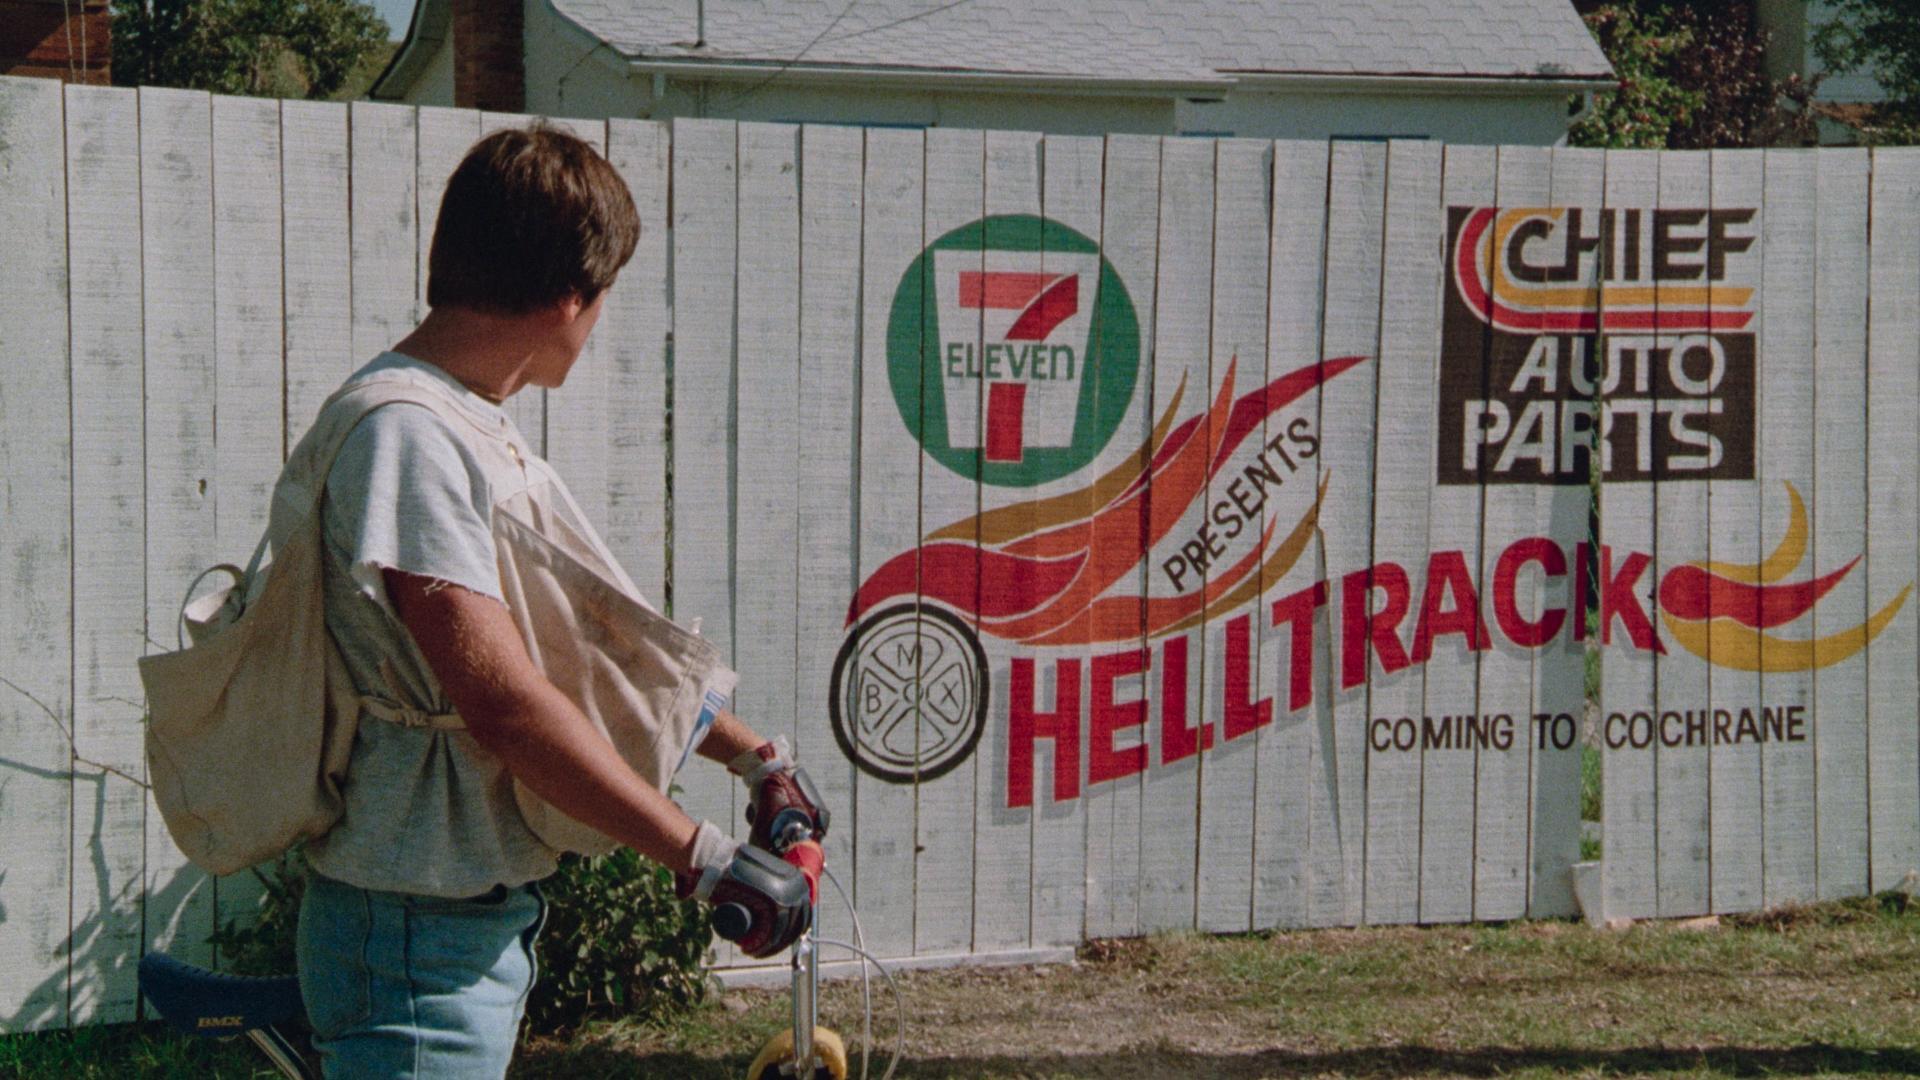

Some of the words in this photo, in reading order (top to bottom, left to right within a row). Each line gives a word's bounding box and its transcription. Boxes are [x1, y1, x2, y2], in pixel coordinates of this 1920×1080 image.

[1507, 208, 1757, 282] CHIEF
[959, 272, 1078, 462] 7
[1509, 335, 1725, 395] AUTO
[1462, 398, 1723, 474] PARTS
[1162, 417, 1319, 592] PRESENTS
[1007, 537, 1668, 808] HELLTRACK
[1370, 713, 1514, 752] COMING
[1532, 713, 1576, 751] TO
[1604, 706, 1806, 750] COCHRANE
